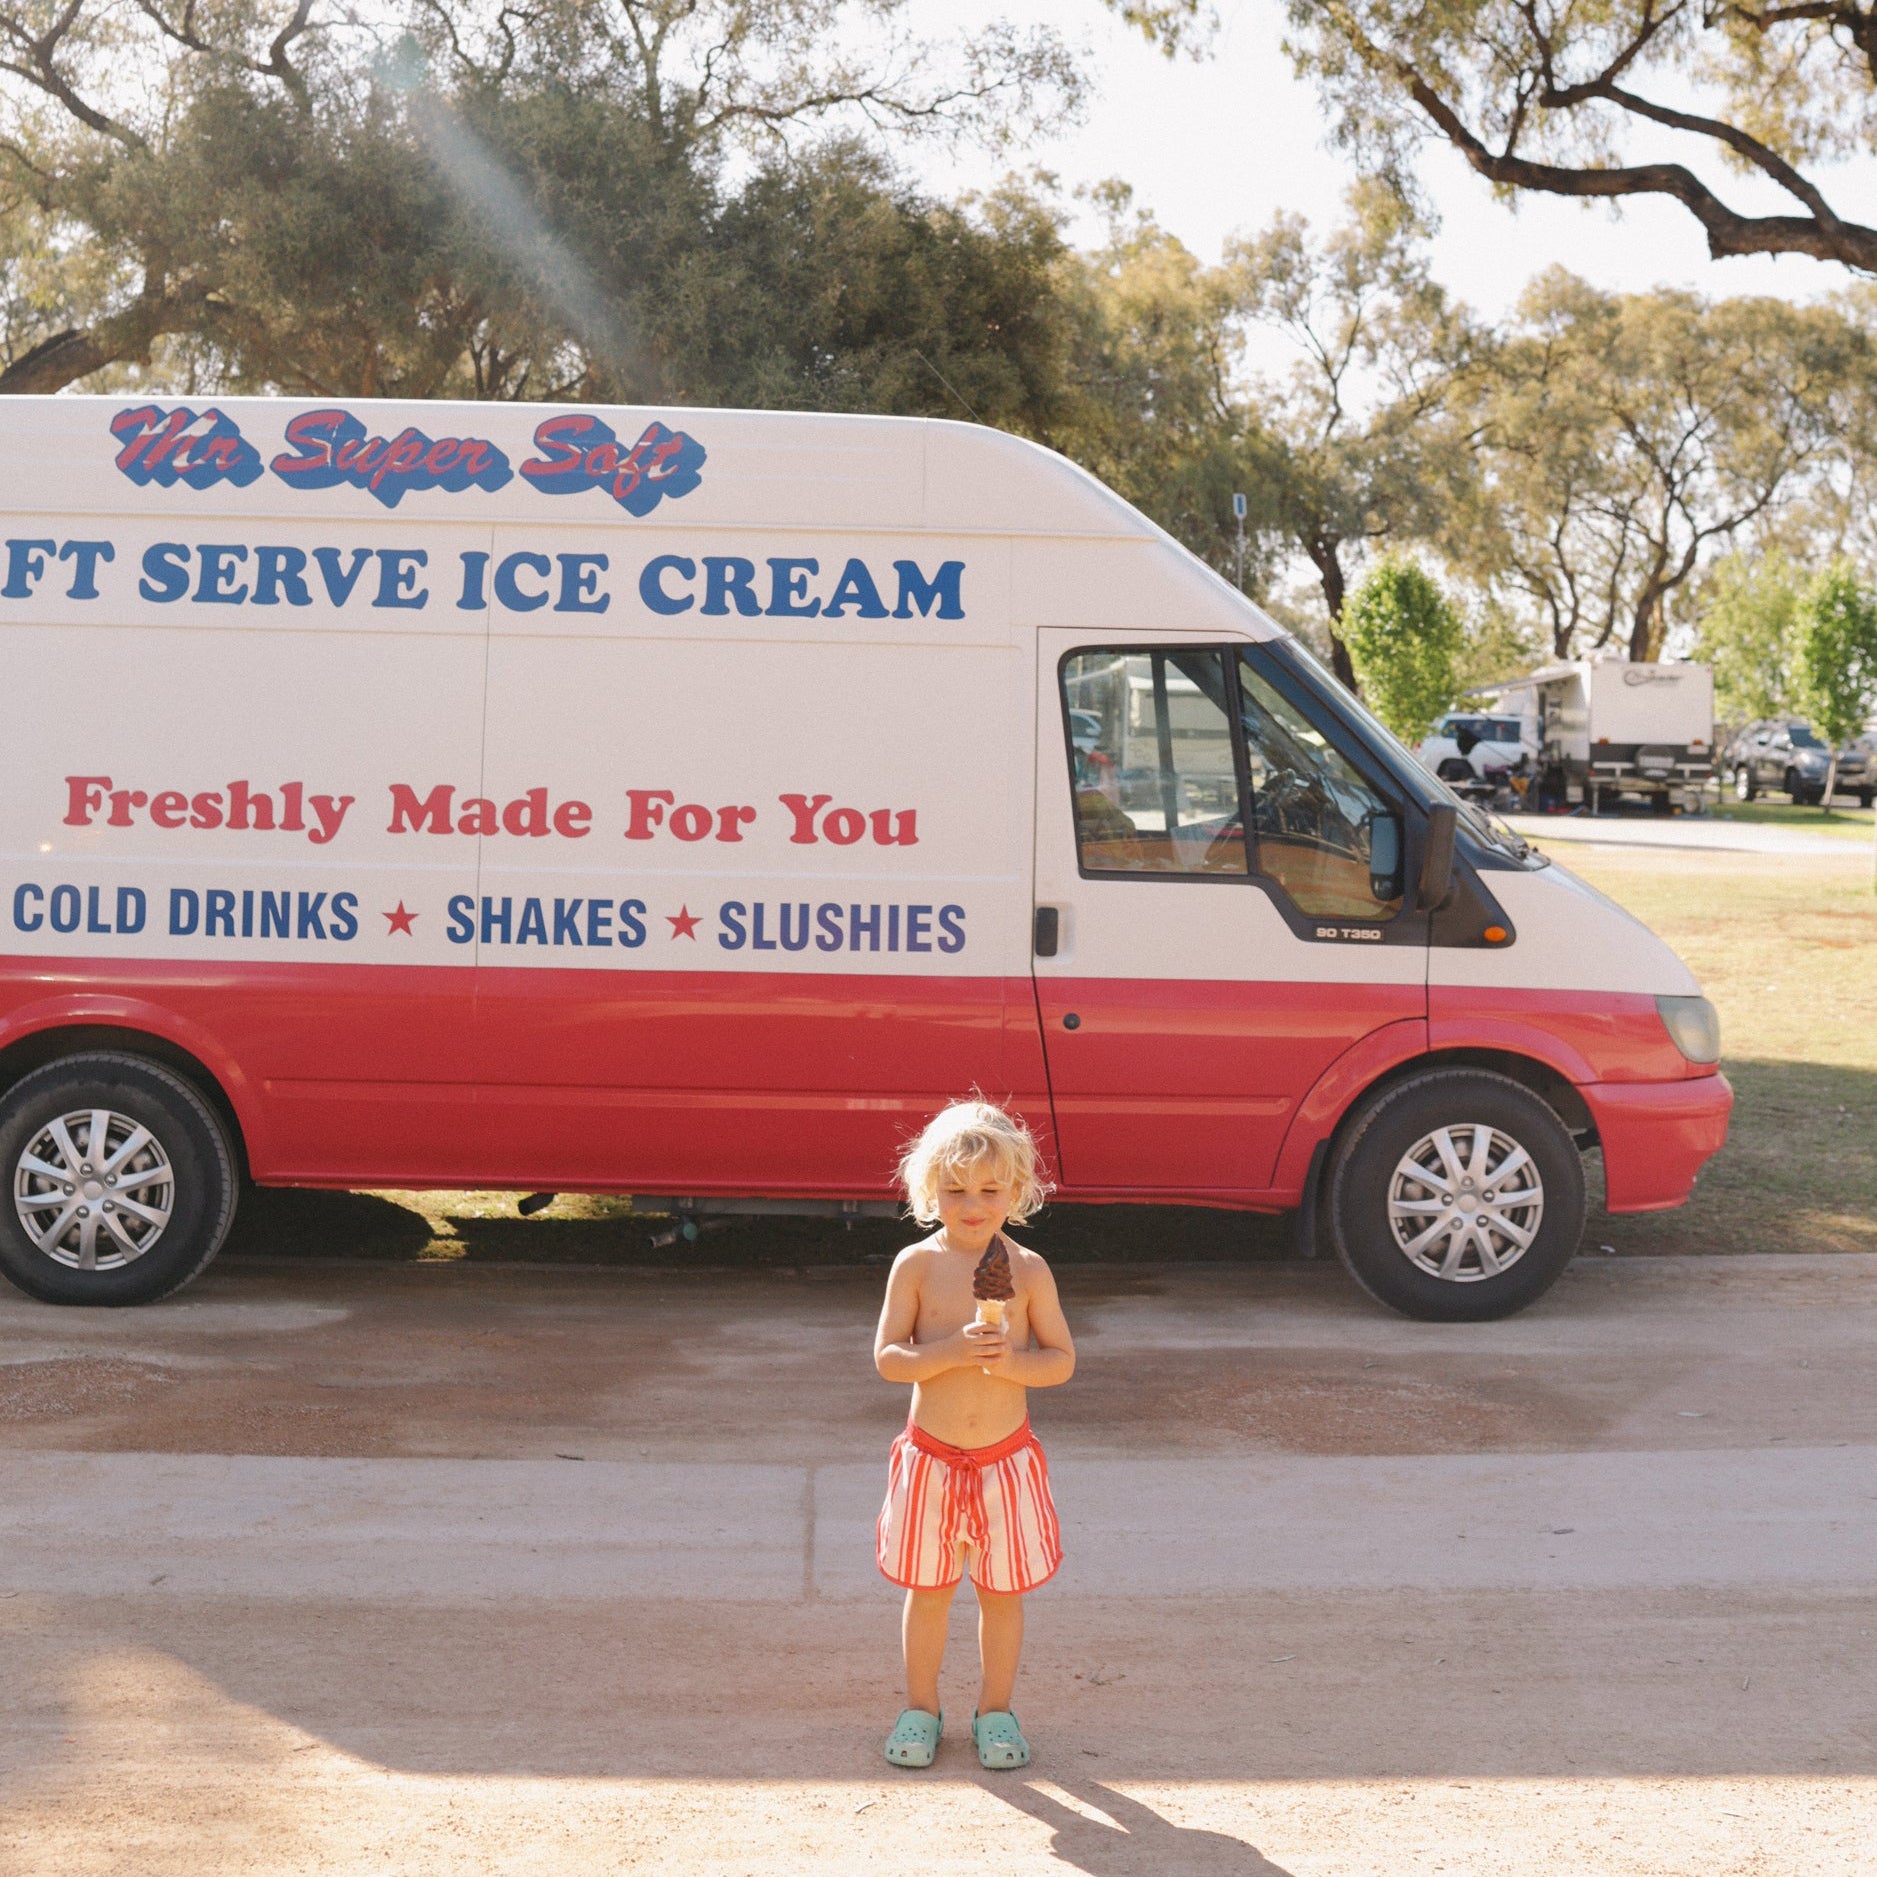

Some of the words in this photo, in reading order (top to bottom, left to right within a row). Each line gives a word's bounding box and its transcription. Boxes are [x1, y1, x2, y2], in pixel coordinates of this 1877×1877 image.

[110, 405, 255, 482] Mr
[269, 408, 505, 500] Super
[518, 413, 696, 509] Soft
[0, 538, 115, 600] FT
[138, 541, 430, 610] SERVE
[456, 550, 612, 614] ICE
[638, 554, 967, 621] CREAM
[62, 775, 357, 845] Freshly
[387, 783, 593, 839] Made
[623, 788, 758, 843] For
[777, 792, 920, 847] You
[13, 883, 147, 935] COLD
[168, 888, 360, 941] DRINKS
[446, 894, 647, 948] SHAKES
[717, 900, 967, 955] SLUSHIES
[1340, 928, 1382, 940] T350
